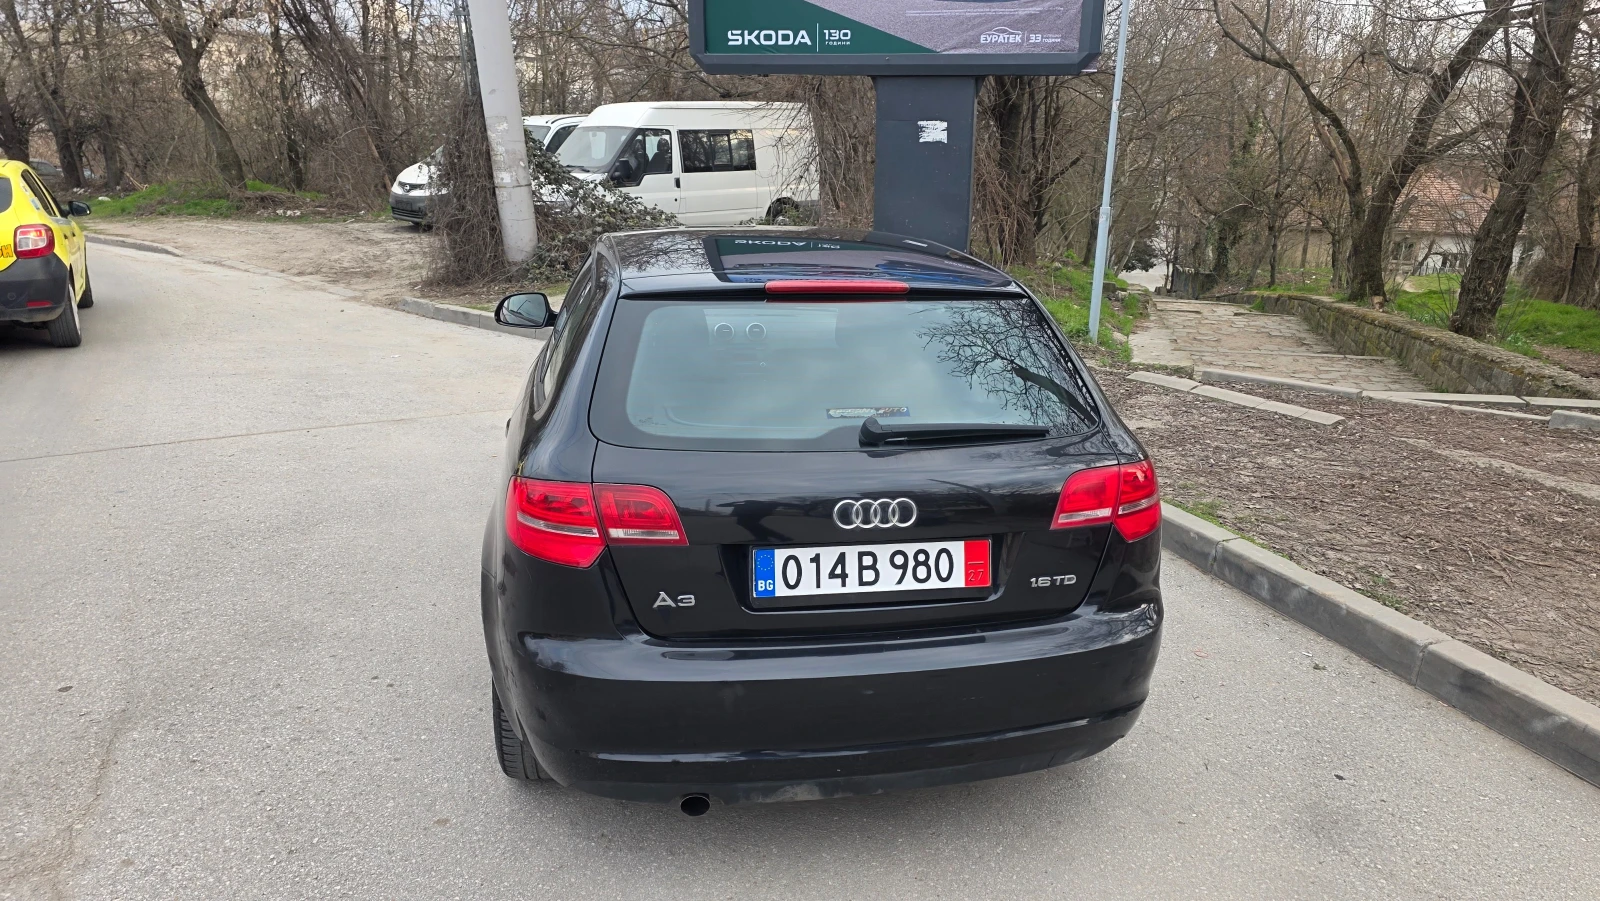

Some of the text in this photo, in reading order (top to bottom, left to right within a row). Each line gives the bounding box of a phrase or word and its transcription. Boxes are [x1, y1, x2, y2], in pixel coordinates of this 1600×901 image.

[823, 29, 851, 40] 130
[980, 34, 1022, 43] ЕУРАТЕК
[1029, 34, 1042, 43] 33
[967, 569, 984, 582] 27
[757, 579, 774, 591] BG
[652, 591, 696, 608] A3
